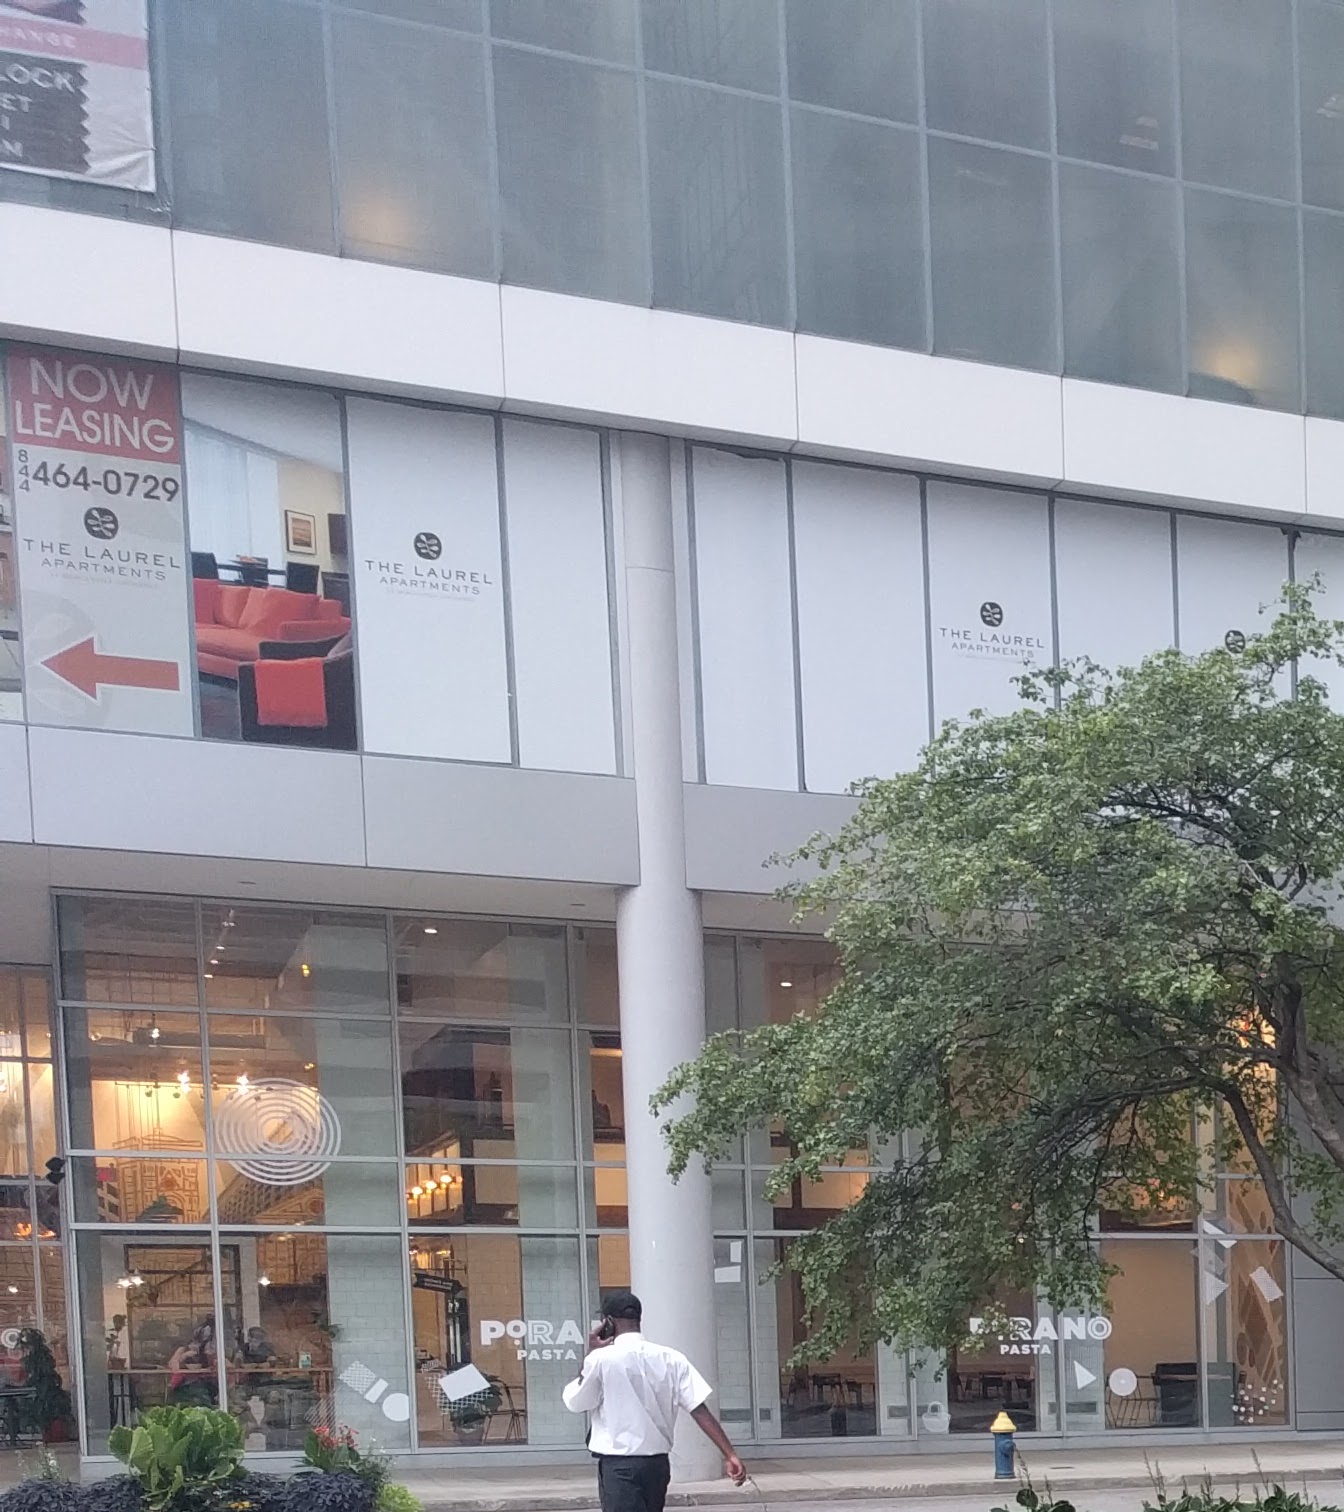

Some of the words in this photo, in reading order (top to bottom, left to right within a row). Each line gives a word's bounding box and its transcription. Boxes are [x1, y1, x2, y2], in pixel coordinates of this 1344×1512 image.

[29, 357, 154, 411] NOW
[15, 400, 175, 453] LEASING
[32, 461, 180, 502] 464-0729
[23, 538, 71, 556] THE
[84, 546, 181, 569] LAUREL
[41, 557, 166, 580] APARTMENTS
[364, 559, 404, 574] THE
[414, 565, 493, 585] LAUREL
[379, 576, 480, 595] APARTMENTS
[939, 627, 972, 641] THE
[980, 632, 1044, 649] LAUREL
[951, 641, 1034, 659] APARTMENTS
[480, 1319, 602, 1346] PORA
[516, 1349, 577, 1361] PASTA
[1000, 1344, 1052, 1355] PASTA
